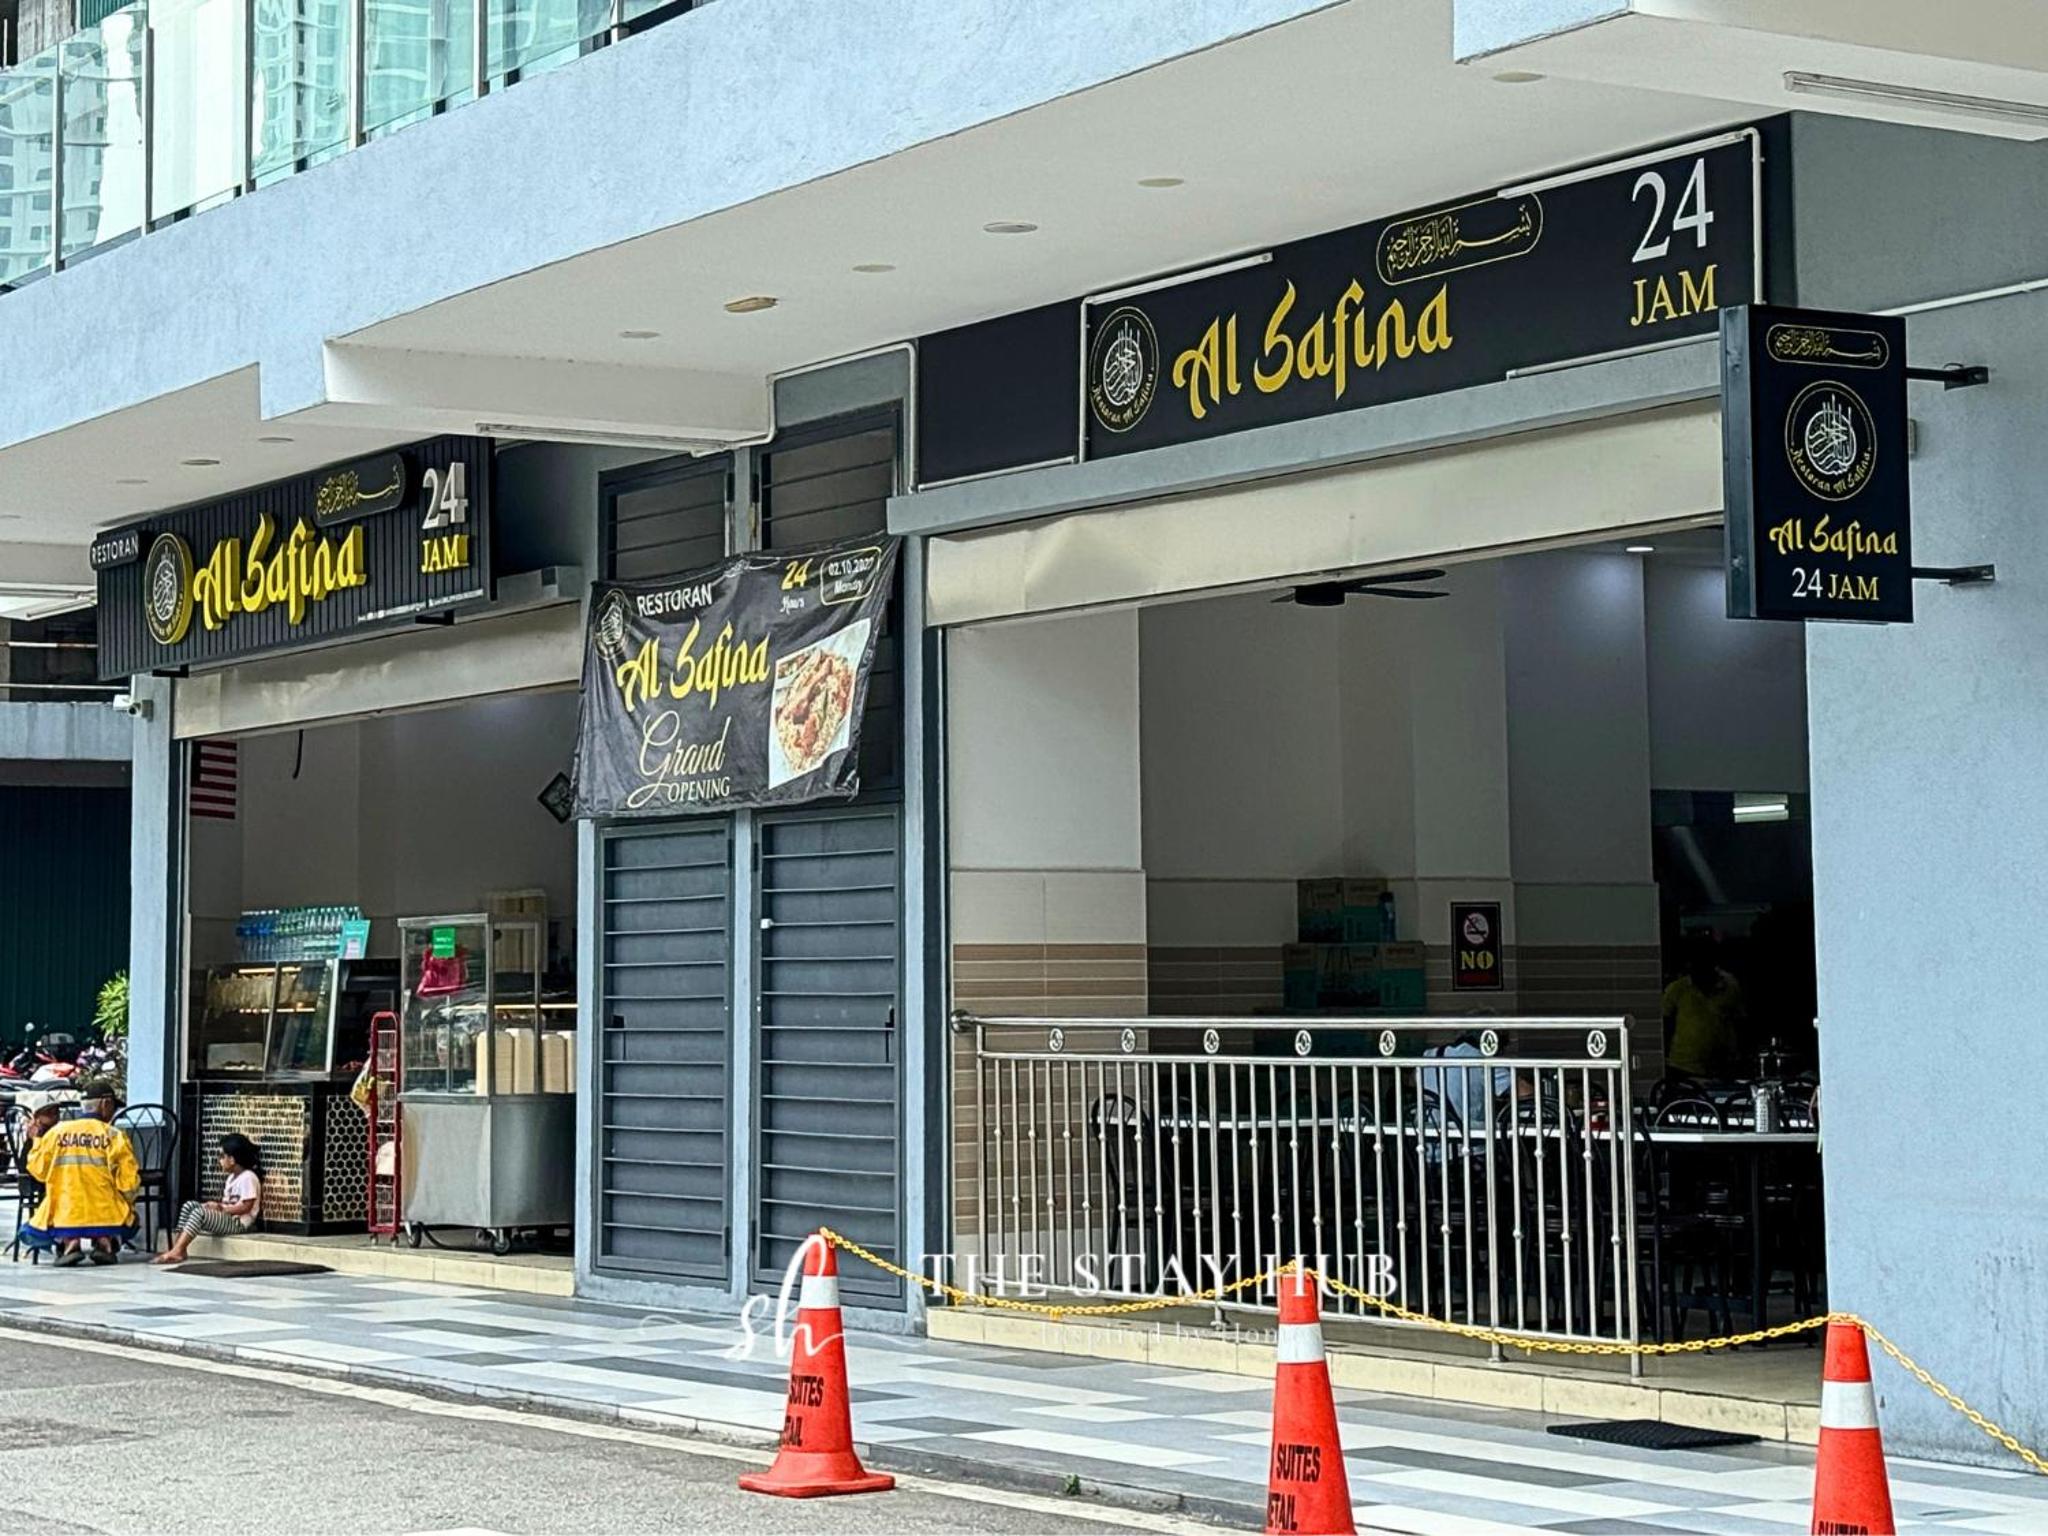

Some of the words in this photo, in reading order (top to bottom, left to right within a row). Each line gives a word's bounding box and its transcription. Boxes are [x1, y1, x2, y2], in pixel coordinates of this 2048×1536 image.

[1631, 157, 1715, 264] 24
[1631, 264, 1719, 326] JAM
[1173, 306, 1241, 419] Al
[1253, 278, 1453, 401] Safina
[422, 462, 467, 530] 24
[91, 535, 139, 564] RESTORAN
[421, 534, 467, 573] JAM
[1769, 518, 1803, 555] Al
[1809, 514, 1898, 561] Safina
[193, 537, 242, 630] Al
[241, 512, 366, 626] Safina
[781, 558, 813, 590] 24
[1791, 567, 1824, 599] 24
[1828, 573, 1880, 601] JAM
[636, 582, 713, 617] RESTORAN
[617, 636, 663, 712] Al
[670, 616, 771, 711] Safina
[627, 710, 732, 808] Grand
[667, 777, 731, 803] OPENING
[1461, 950, 1494, 970] NO
[789, 1374, 824, 1407] SUITES
[1276, 1443, 1321, 1483] SUITES
